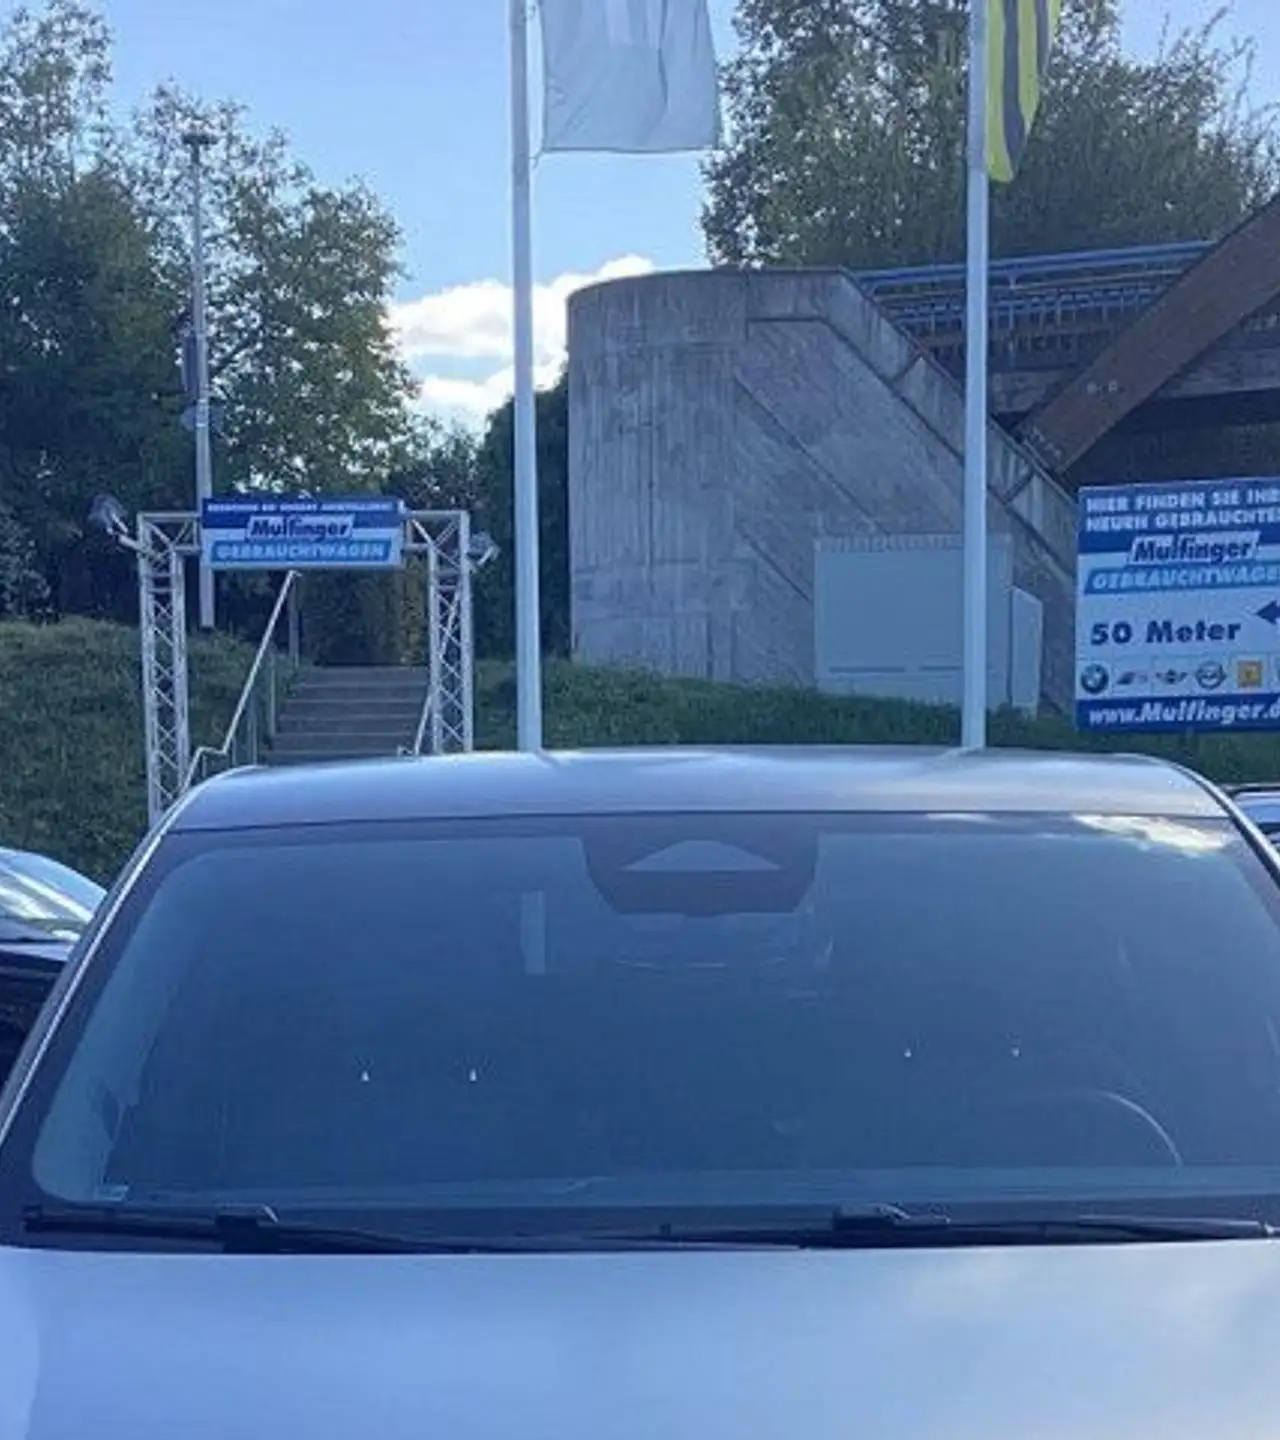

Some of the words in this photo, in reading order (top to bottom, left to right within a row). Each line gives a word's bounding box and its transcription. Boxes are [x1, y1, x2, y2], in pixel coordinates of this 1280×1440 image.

[1136, 491, 1206, 511] FINDEN
[1212, 488, 1240, 505] SIE
[1132, 537, 1256, 563] Mulfinger
[1091, 621, 1133, 645] 50
[1145, 619, 1241, 644] Meter
